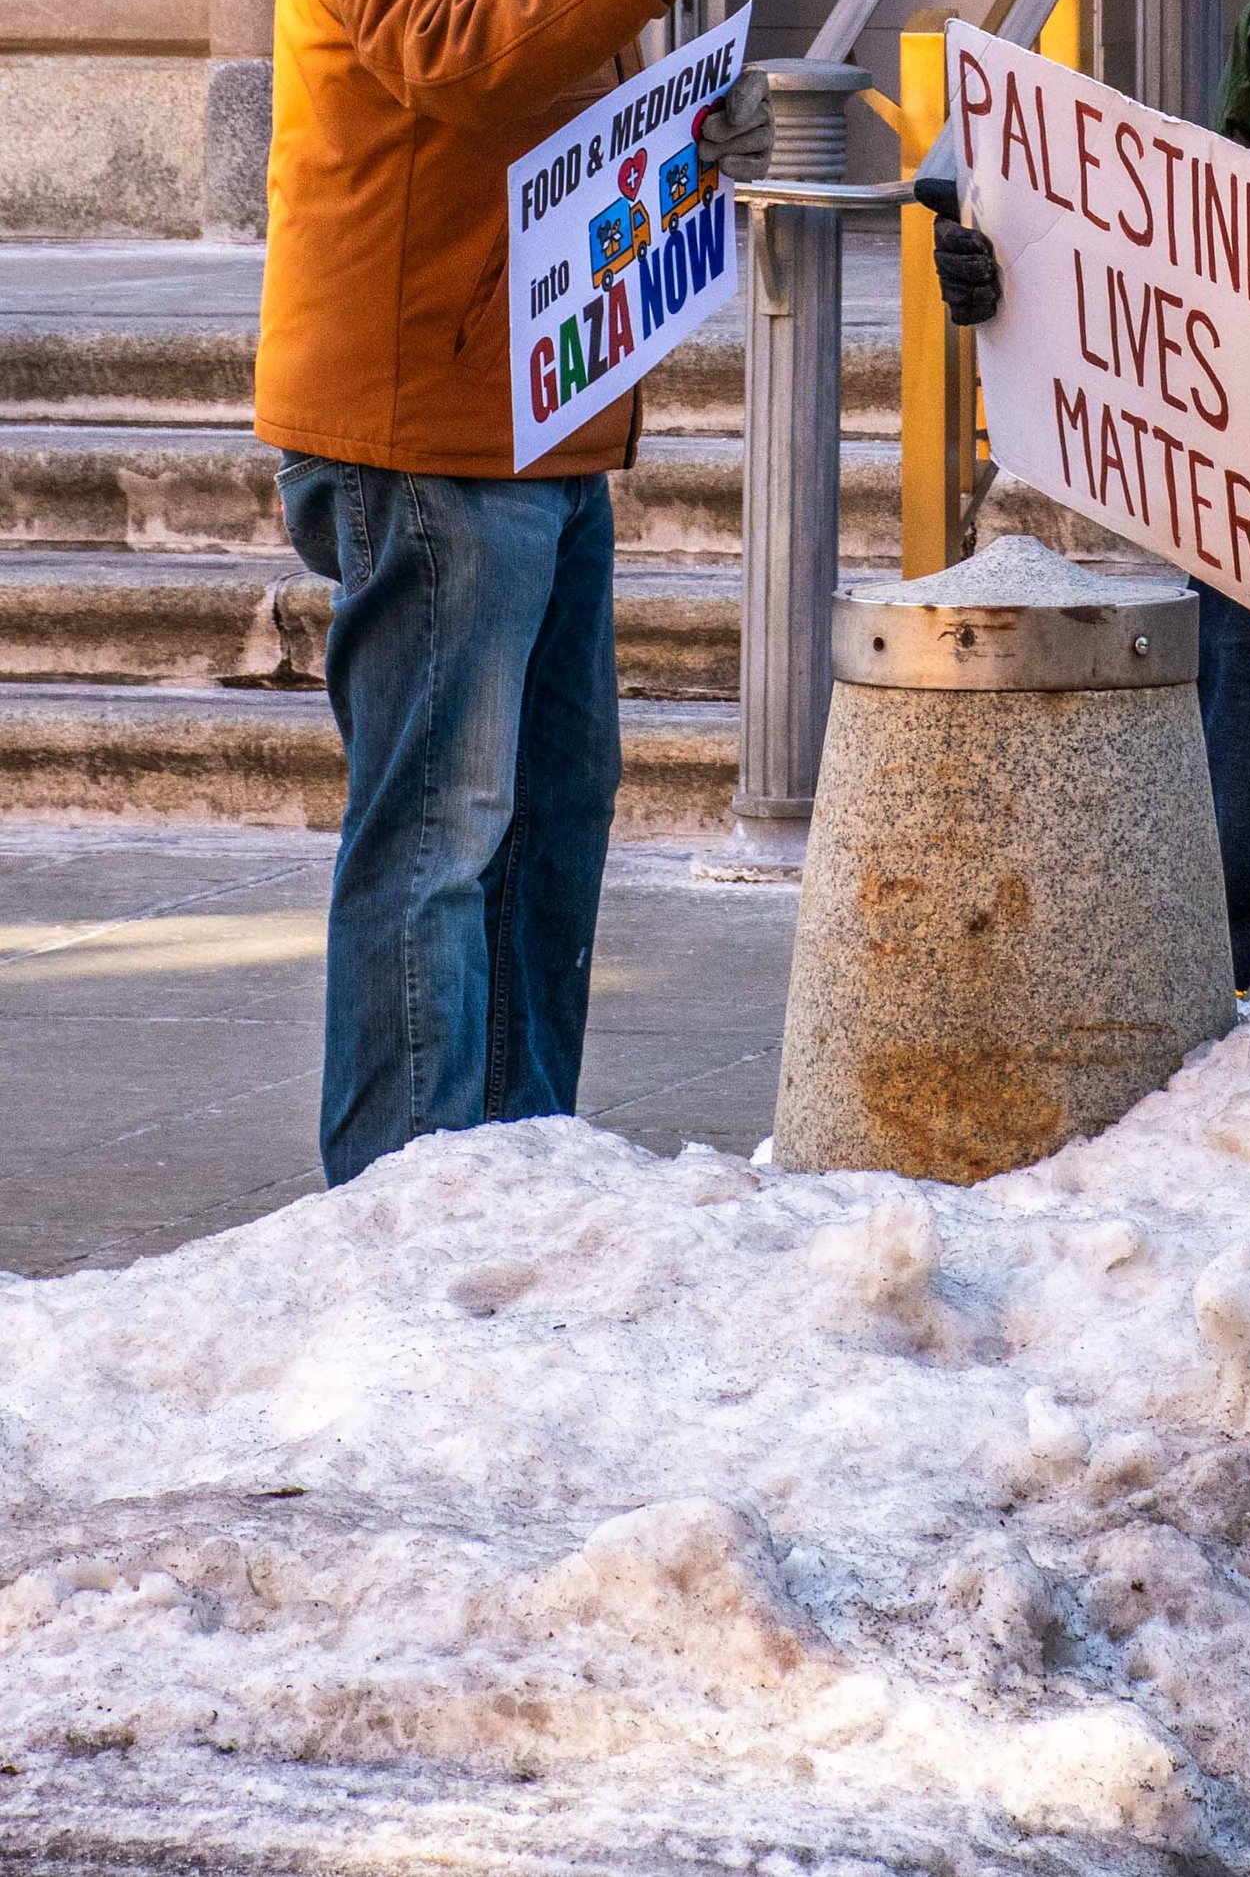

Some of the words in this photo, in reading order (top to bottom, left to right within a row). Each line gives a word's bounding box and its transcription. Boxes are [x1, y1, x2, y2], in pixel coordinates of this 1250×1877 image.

[521, 147, 581, 232] FOOD
[587, 135, 604, 177] &
[609, 38, 736, 162] MEDICINE
[530, 259, 570, 320] into
[530, 278, 636, 424] GAZA
[639, 193, 727, 340] NOW
[1073, 248, 1230, 432] LIVES
